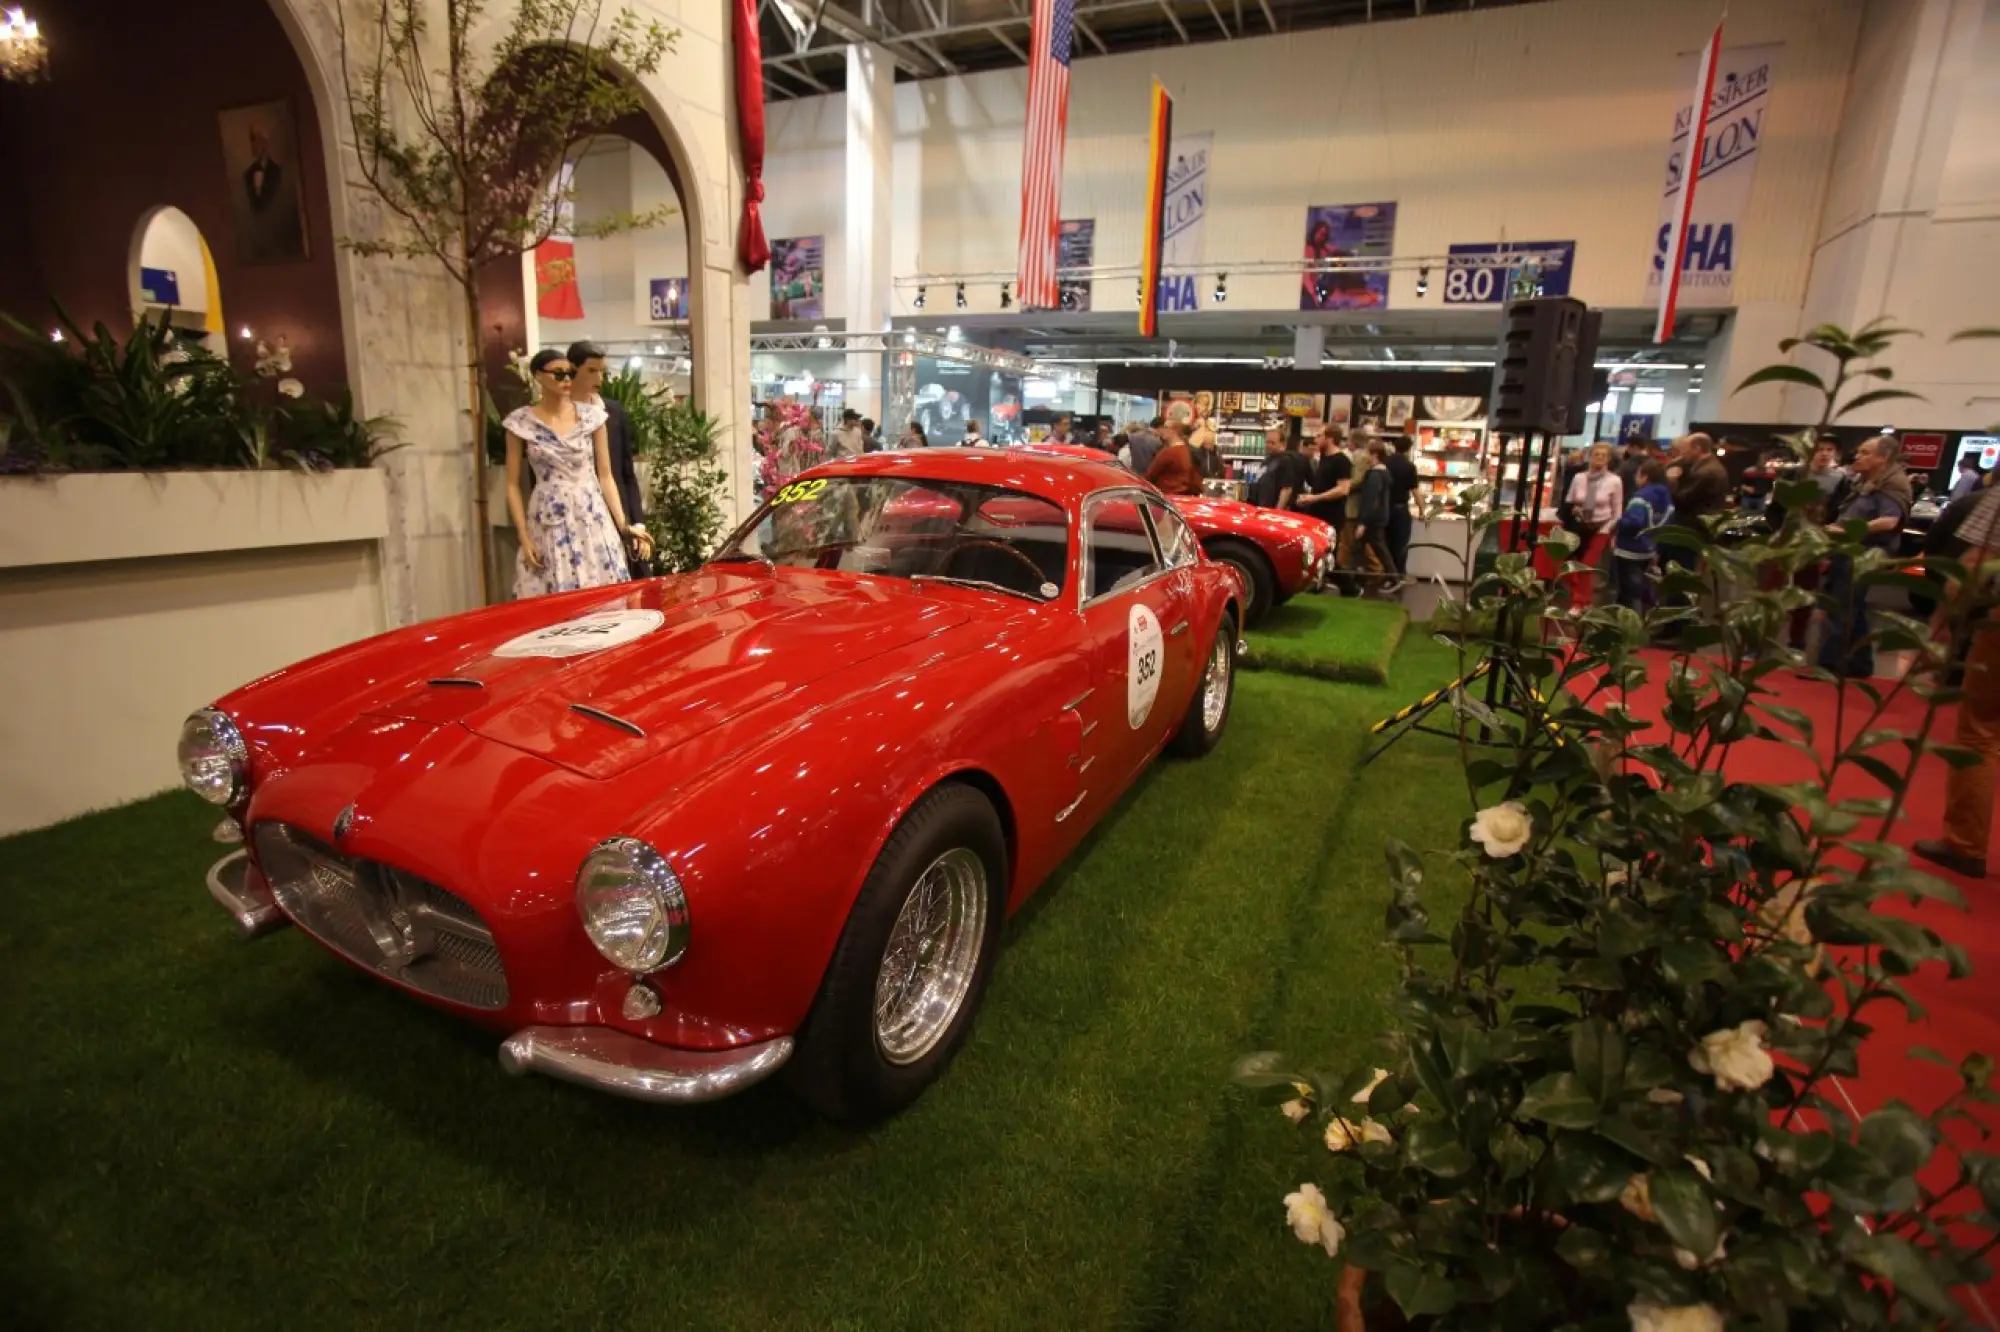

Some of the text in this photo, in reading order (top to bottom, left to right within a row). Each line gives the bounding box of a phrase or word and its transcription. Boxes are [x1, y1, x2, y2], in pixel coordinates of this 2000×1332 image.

[1674, 64, 1769, 133] KLSSIKER
[1666, 108, 1763, 187] SLON
[1166, 181, 1205, 231] LON
[1653, 222, 1733, 271] SHA
[1447, 267, 1494, 301] 8.0
[652, 296, 672, 318] 8.1
[770, 478, 828, 506] 352
[1137, 648, 1156, 685] 352
